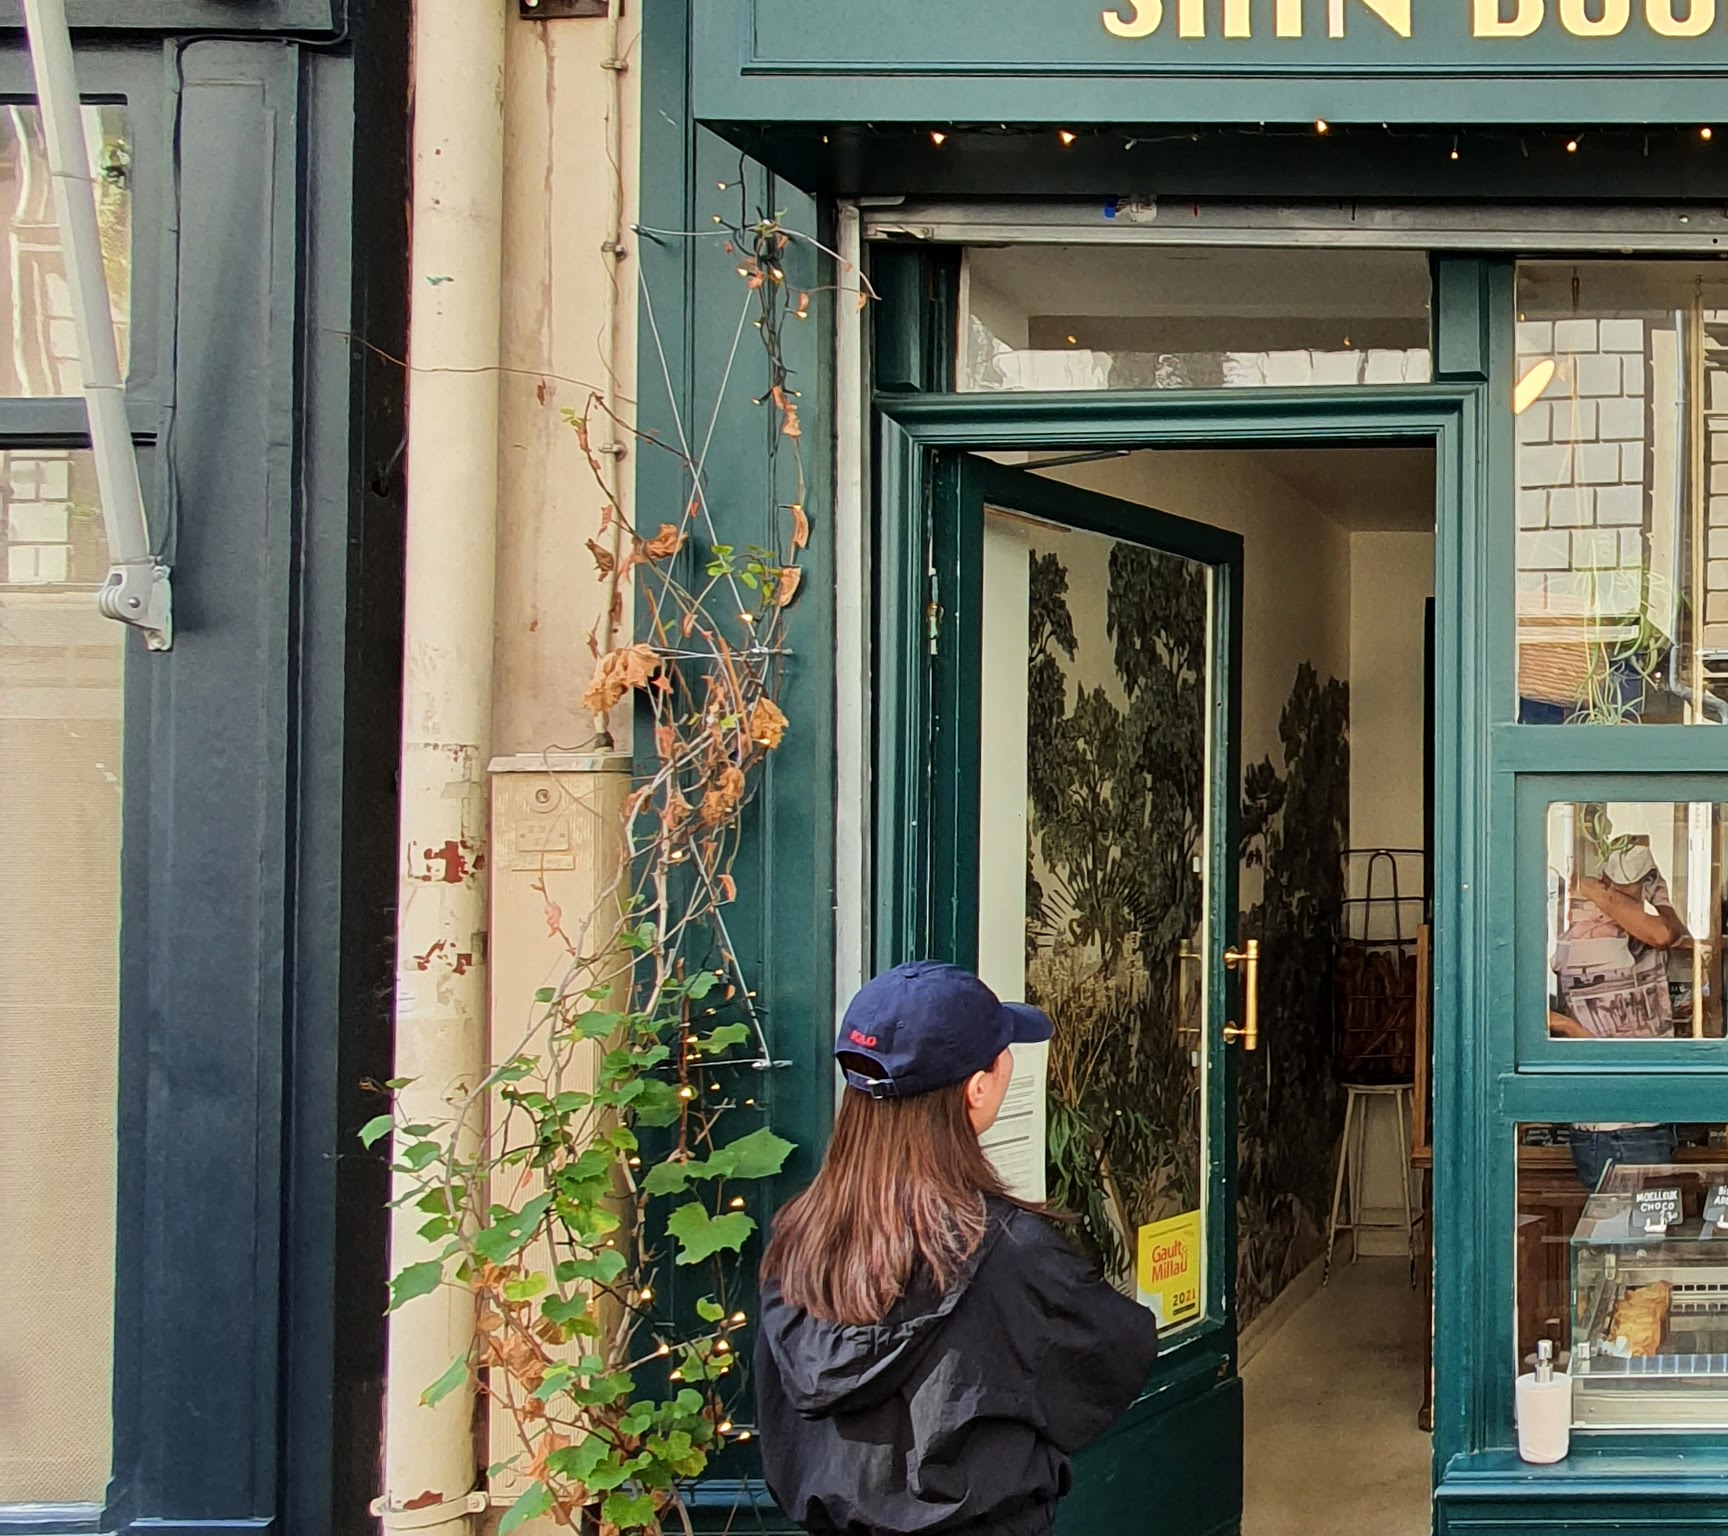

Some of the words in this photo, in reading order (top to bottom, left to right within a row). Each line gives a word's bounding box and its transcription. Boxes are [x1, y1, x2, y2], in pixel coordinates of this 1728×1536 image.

[1636, 1190, 1678, 1202] MOELLEUX
[1640, 1202, 1675, 1212] CHOCO
[1152, 1239, 1182, 1263] Gault
[1151, 1254, 1188, 1283] Millau
[1173, 1288, 1196, 1306] 2021
